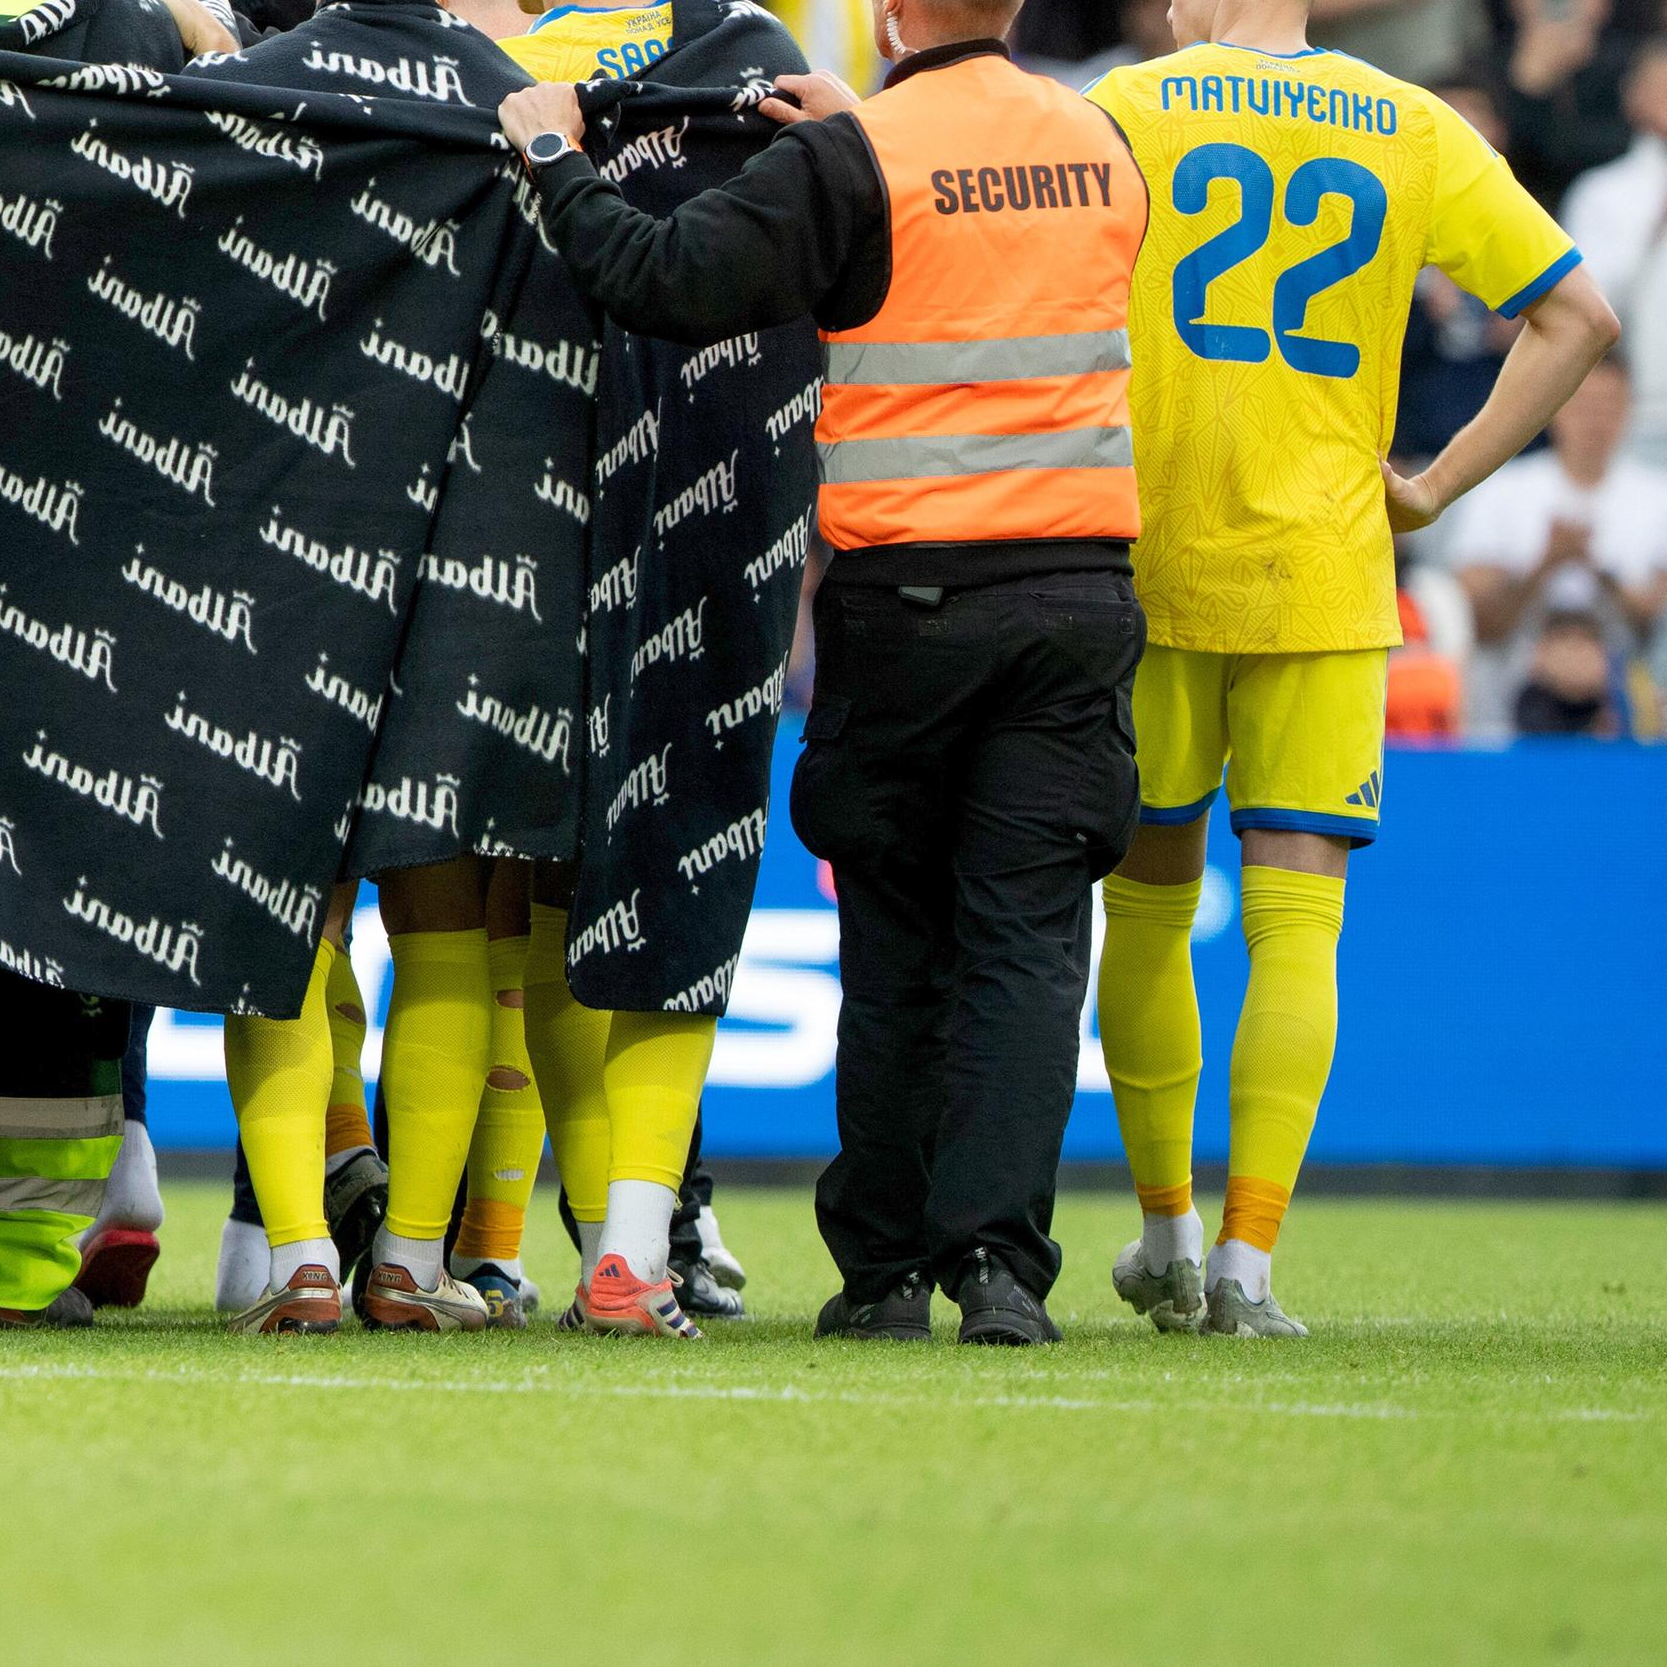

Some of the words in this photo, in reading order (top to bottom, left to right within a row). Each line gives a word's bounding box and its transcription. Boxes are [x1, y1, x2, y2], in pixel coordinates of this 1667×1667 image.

[1161, 75, 1398, 136] MATVIYENKO
[931, 162, 1113, 216] SECURITY
[1171, 142, 1389, 380] 22
[653, 449, 739, 551] Albani
